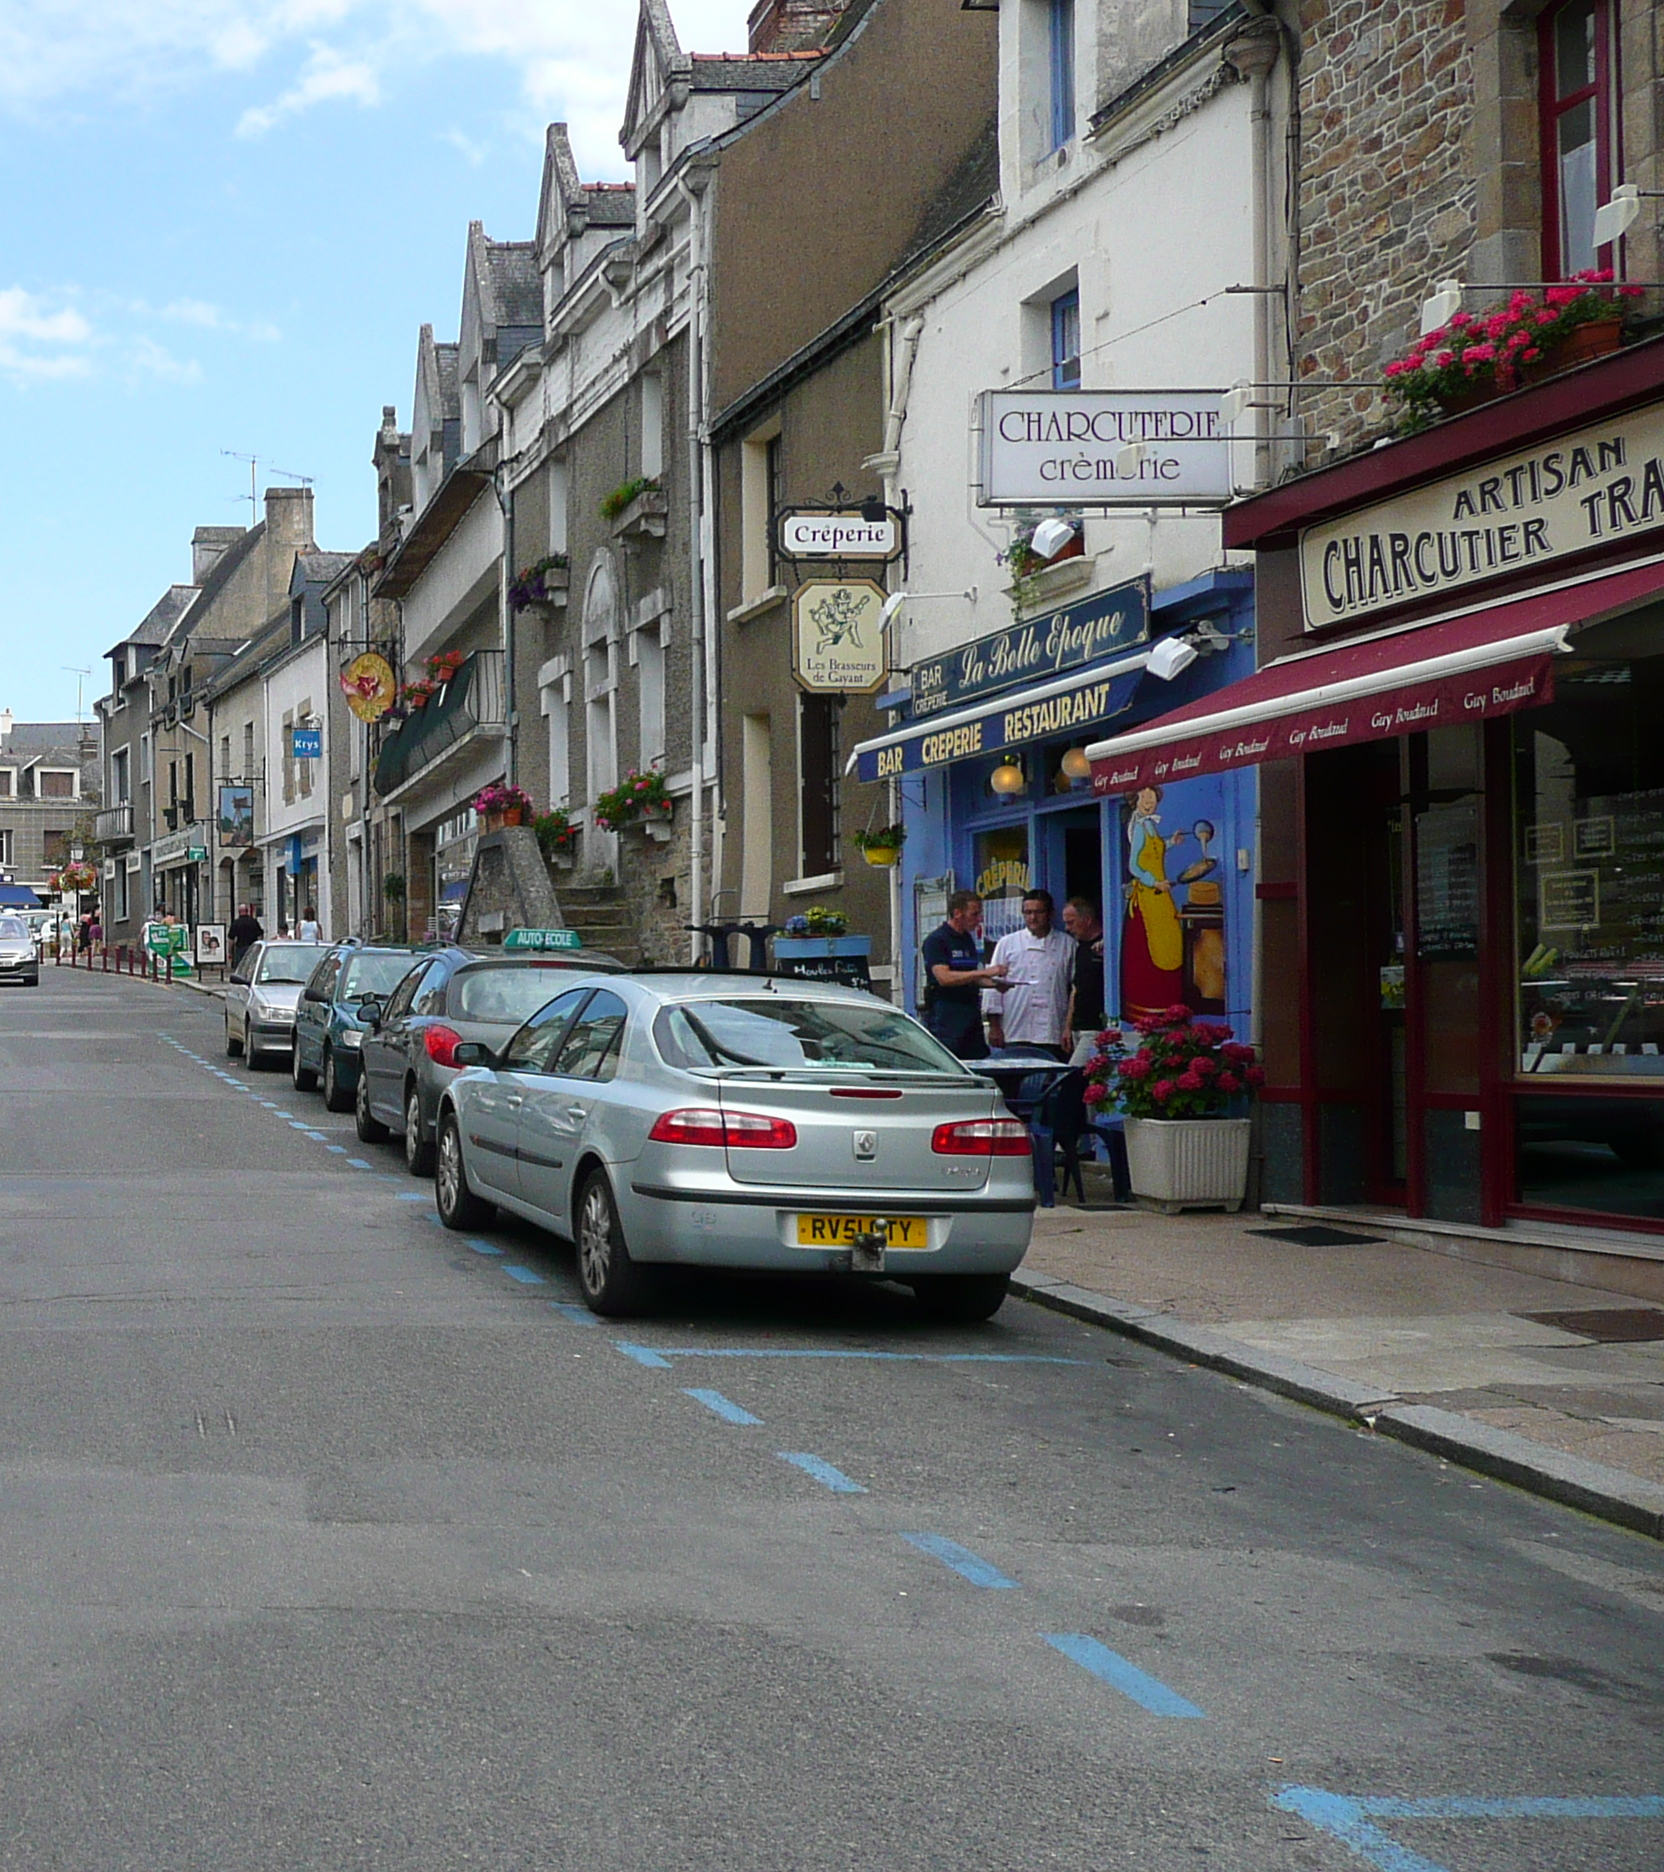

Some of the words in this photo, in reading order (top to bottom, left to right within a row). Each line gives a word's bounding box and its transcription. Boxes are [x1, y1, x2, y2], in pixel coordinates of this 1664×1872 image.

[999, 411, 1220, 442] CHARCUTERIE
[1452, 436, 1628, 521] ARTISAN
[795, 525, 885, 550] Crêperie
[1322, 517, 1552, 614] CHARCUTIER
[807, 658, 825, 671] Les
[829, 658, 877, 672] Brasseurs
[958, 644, 985, 690] La
[988, 624, 1043, 679] Belle
[813, 673, 824, 683] de
[921, 665, 942, 690] BAR
[1464, 693, 1487, 713] Guy
[877, 745, 903, 777] BAR
[921, 722, 982, 764] CREPERIE
[1004, 682, 1110, 743] RESTAURANT
[1371, 712, 1393, 732] Guy
[295, 739, 319, 751] Krys
